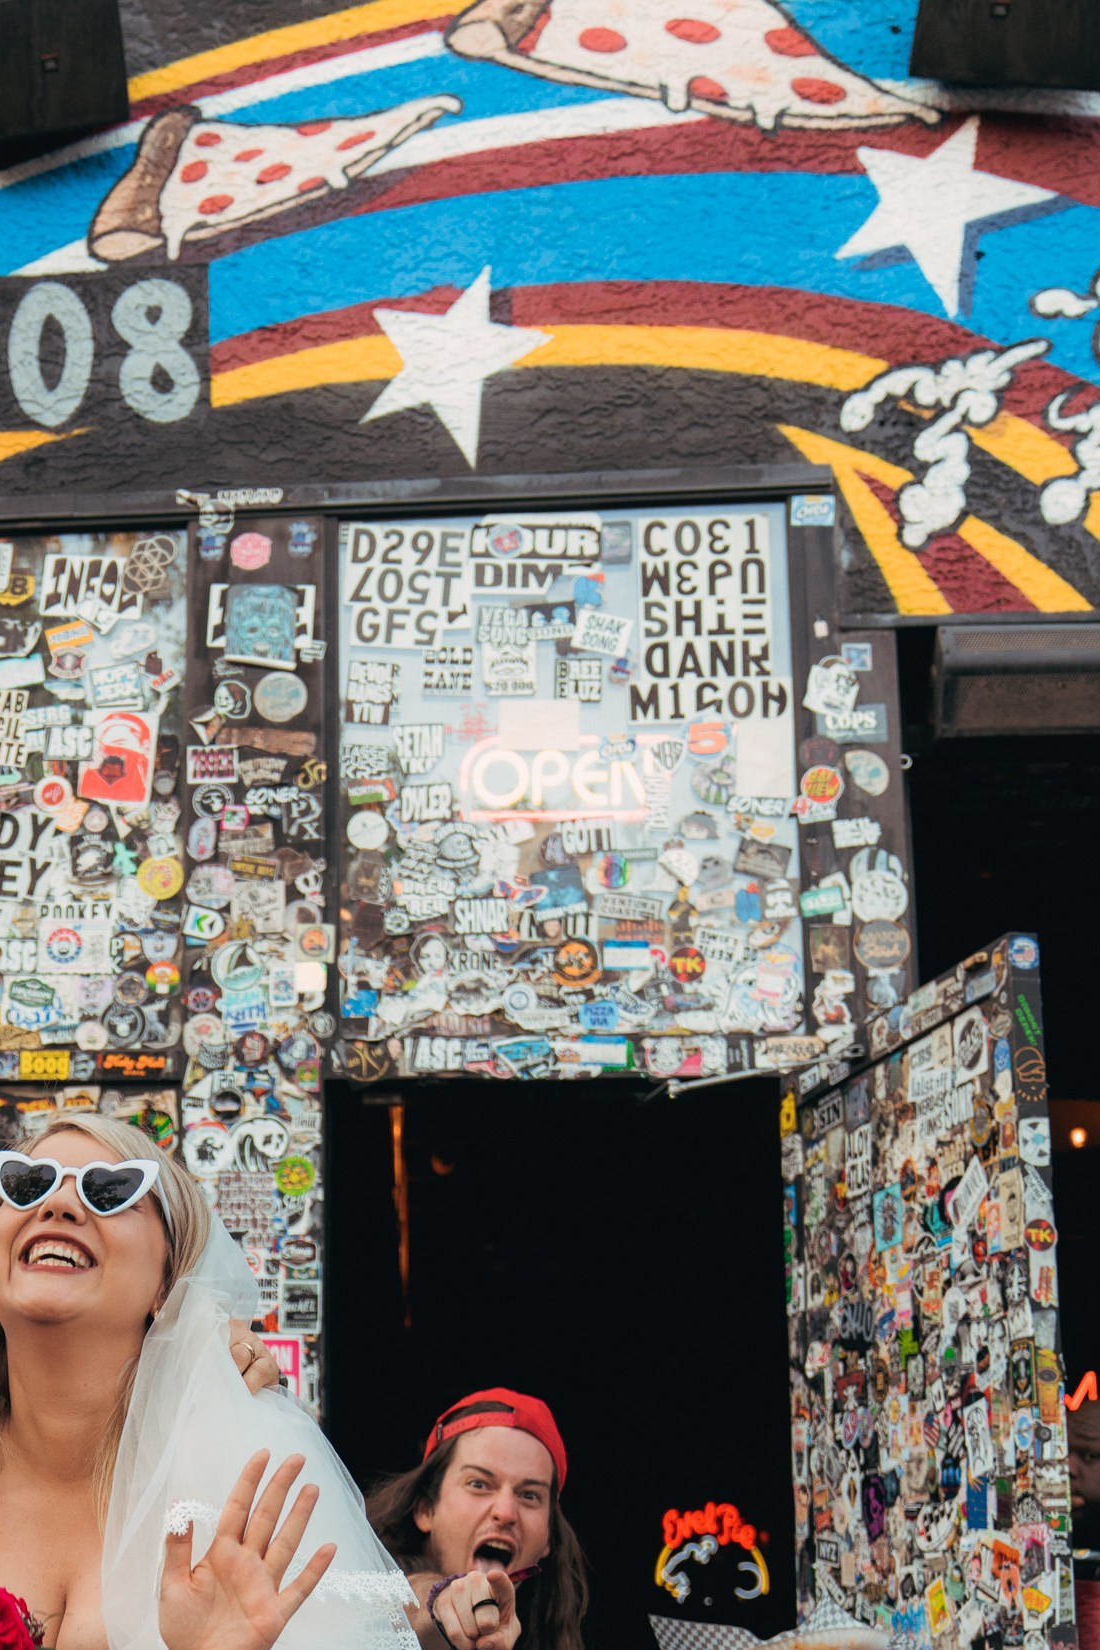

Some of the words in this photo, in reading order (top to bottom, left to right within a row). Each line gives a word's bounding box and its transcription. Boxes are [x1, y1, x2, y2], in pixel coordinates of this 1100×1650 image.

[688, 722, 729, 755] 5
[472, 750, 654, 807] OPEN
[670, 955, 702, 975] TK
[21, 1051, 70, 1080] Boog
[1027, 1228, 1051, 1243] TK
[662, 1502, 718, 1548] Evel
[718, 1503, 757, 1550] Pie
